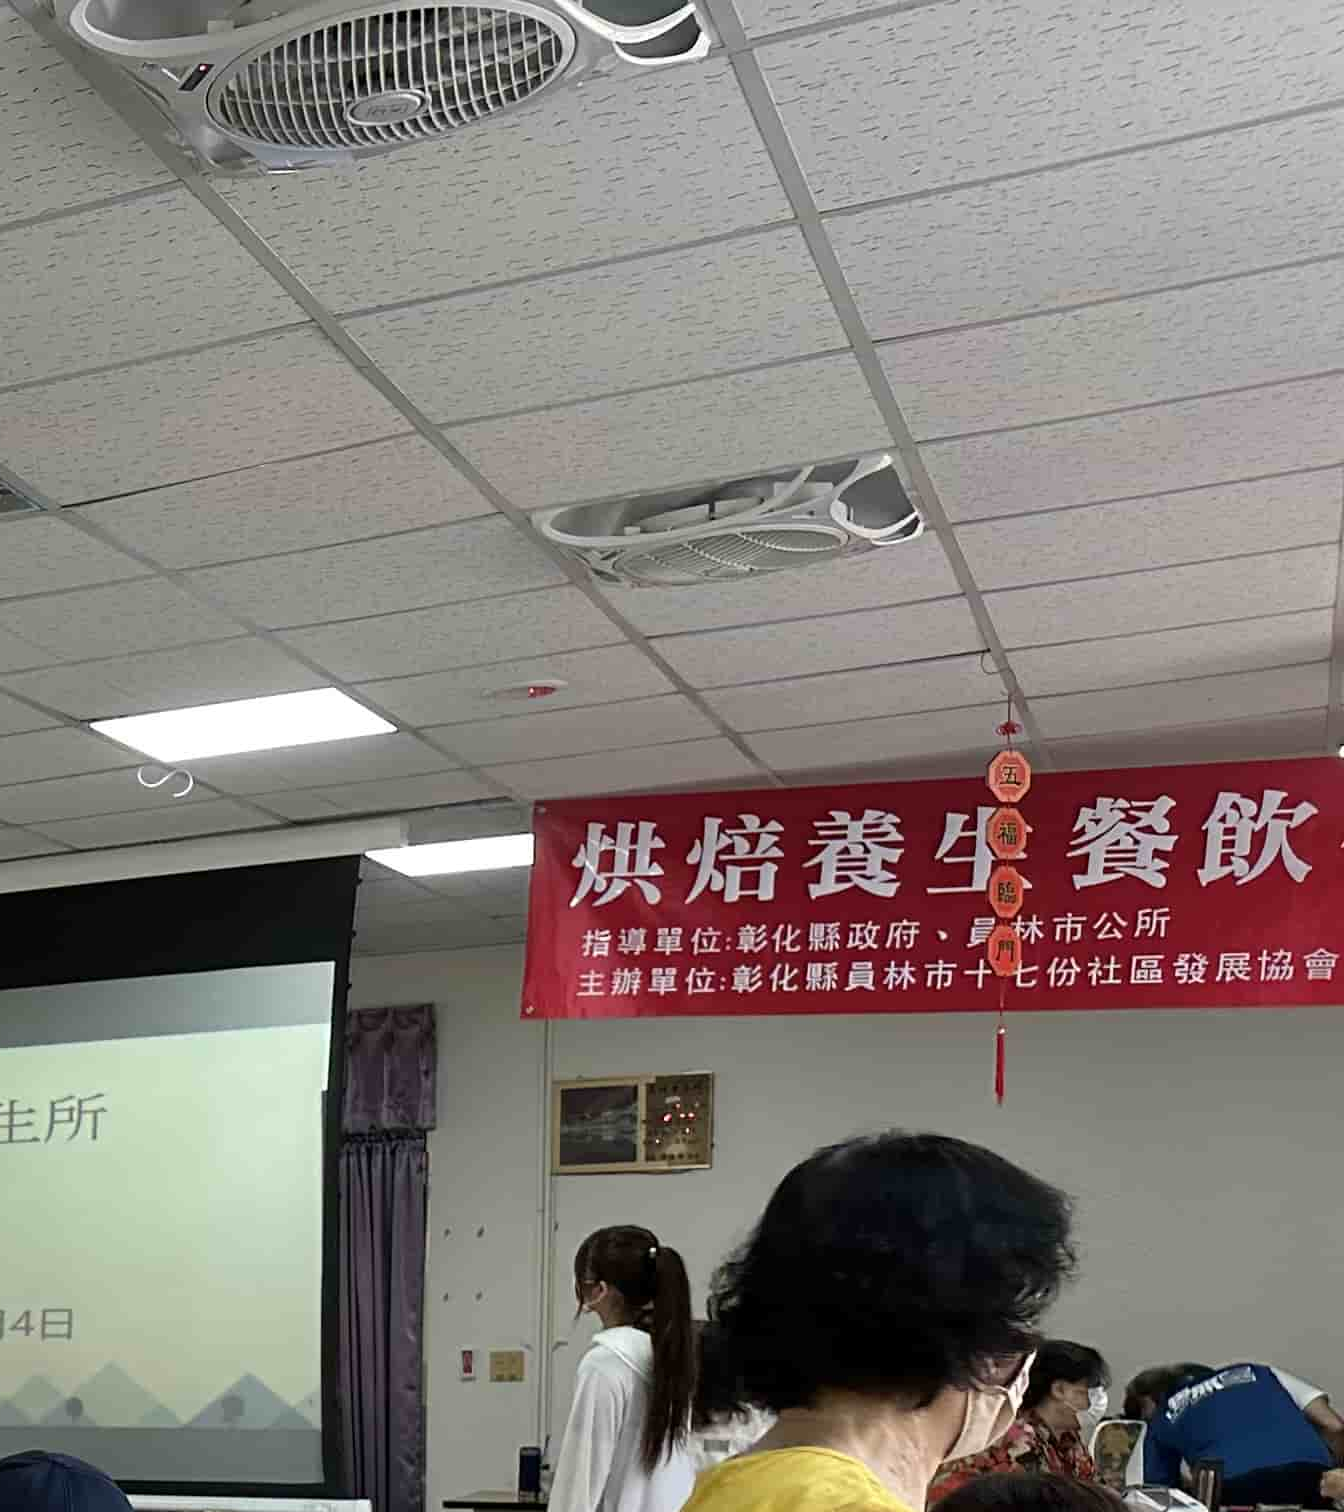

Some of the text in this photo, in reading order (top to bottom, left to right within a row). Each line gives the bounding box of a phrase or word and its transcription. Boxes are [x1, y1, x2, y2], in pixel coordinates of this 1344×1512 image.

[569, 790, 1319, 908] 烘焙養生餐飲
